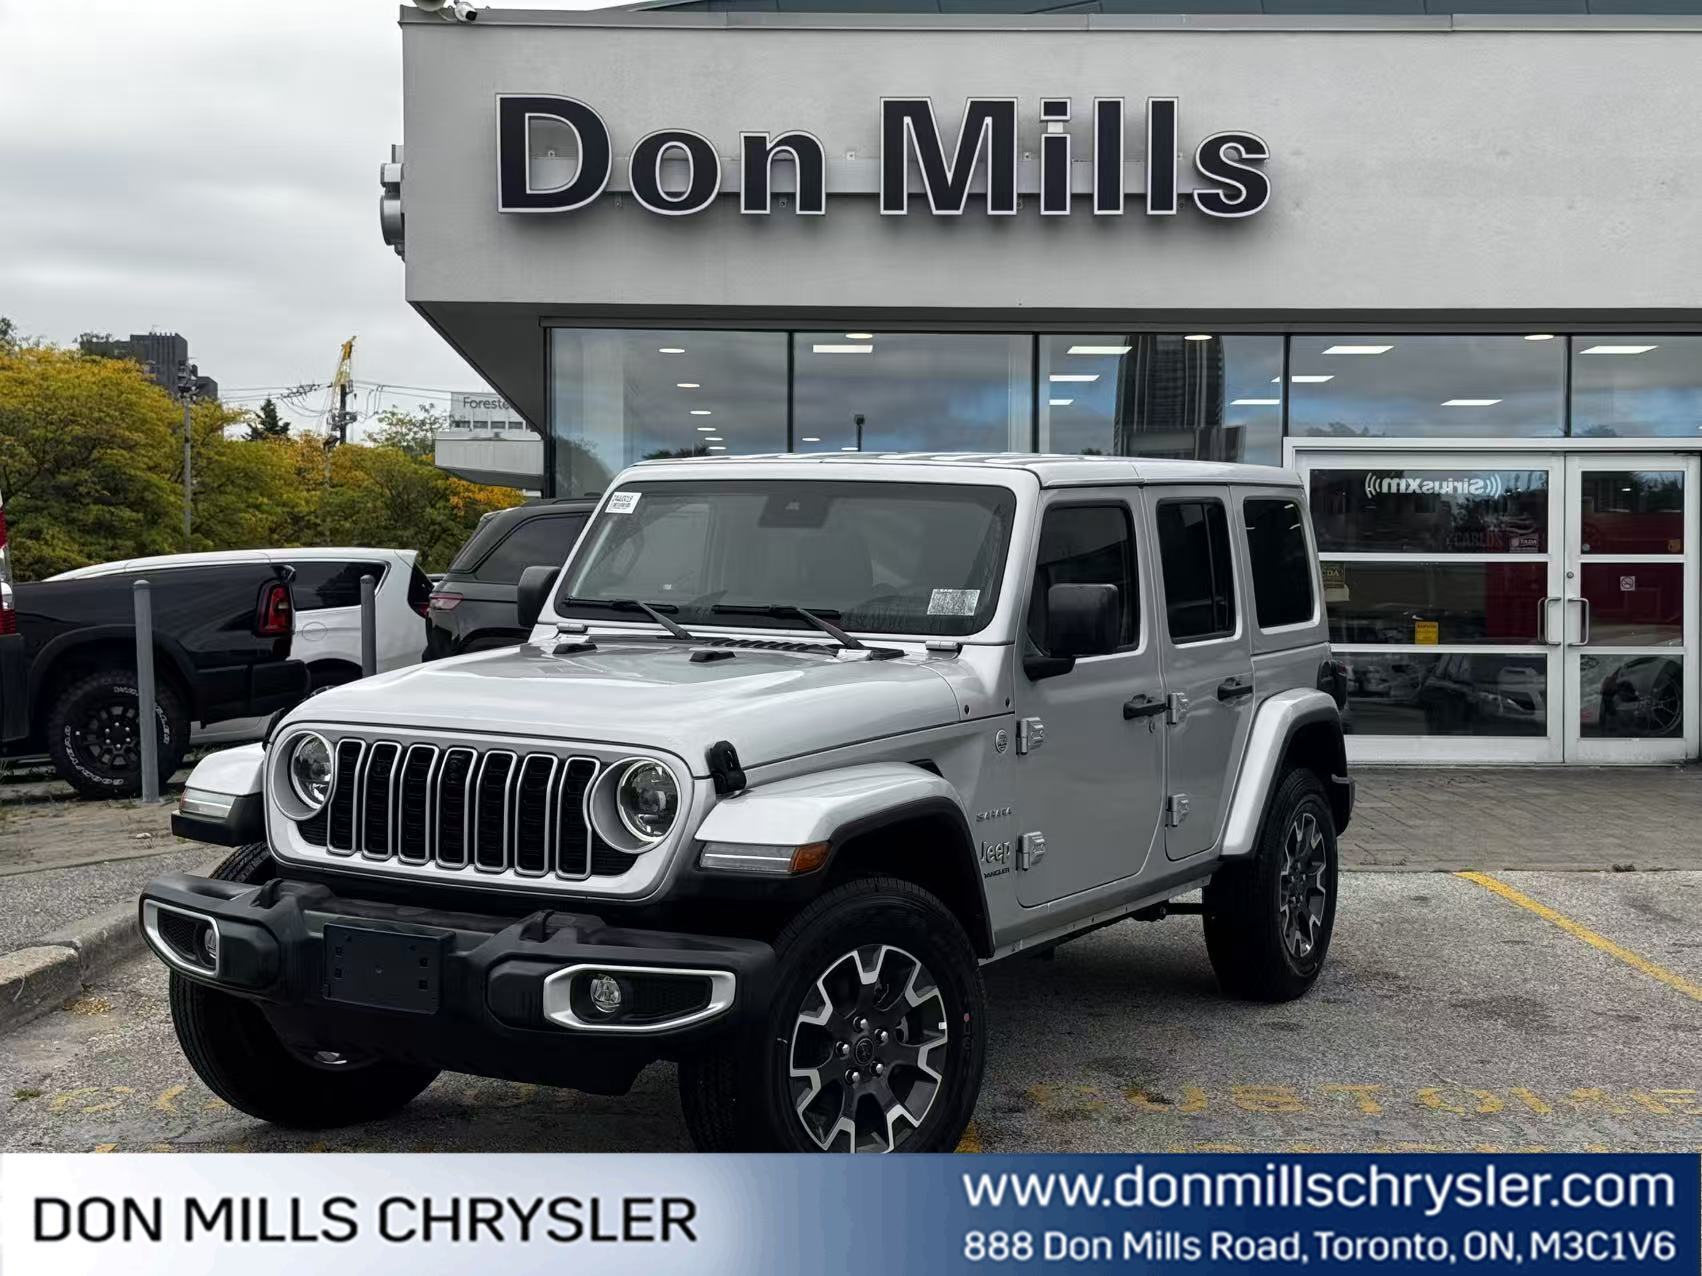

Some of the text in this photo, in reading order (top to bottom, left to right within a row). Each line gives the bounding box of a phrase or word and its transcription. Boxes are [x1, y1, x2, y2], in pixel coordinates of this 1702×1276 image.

[494, 92, 1271, 219] Don Mills
[463, 396, 513, 410] Foreste
[981, 840, 1010, 864] Jeep
